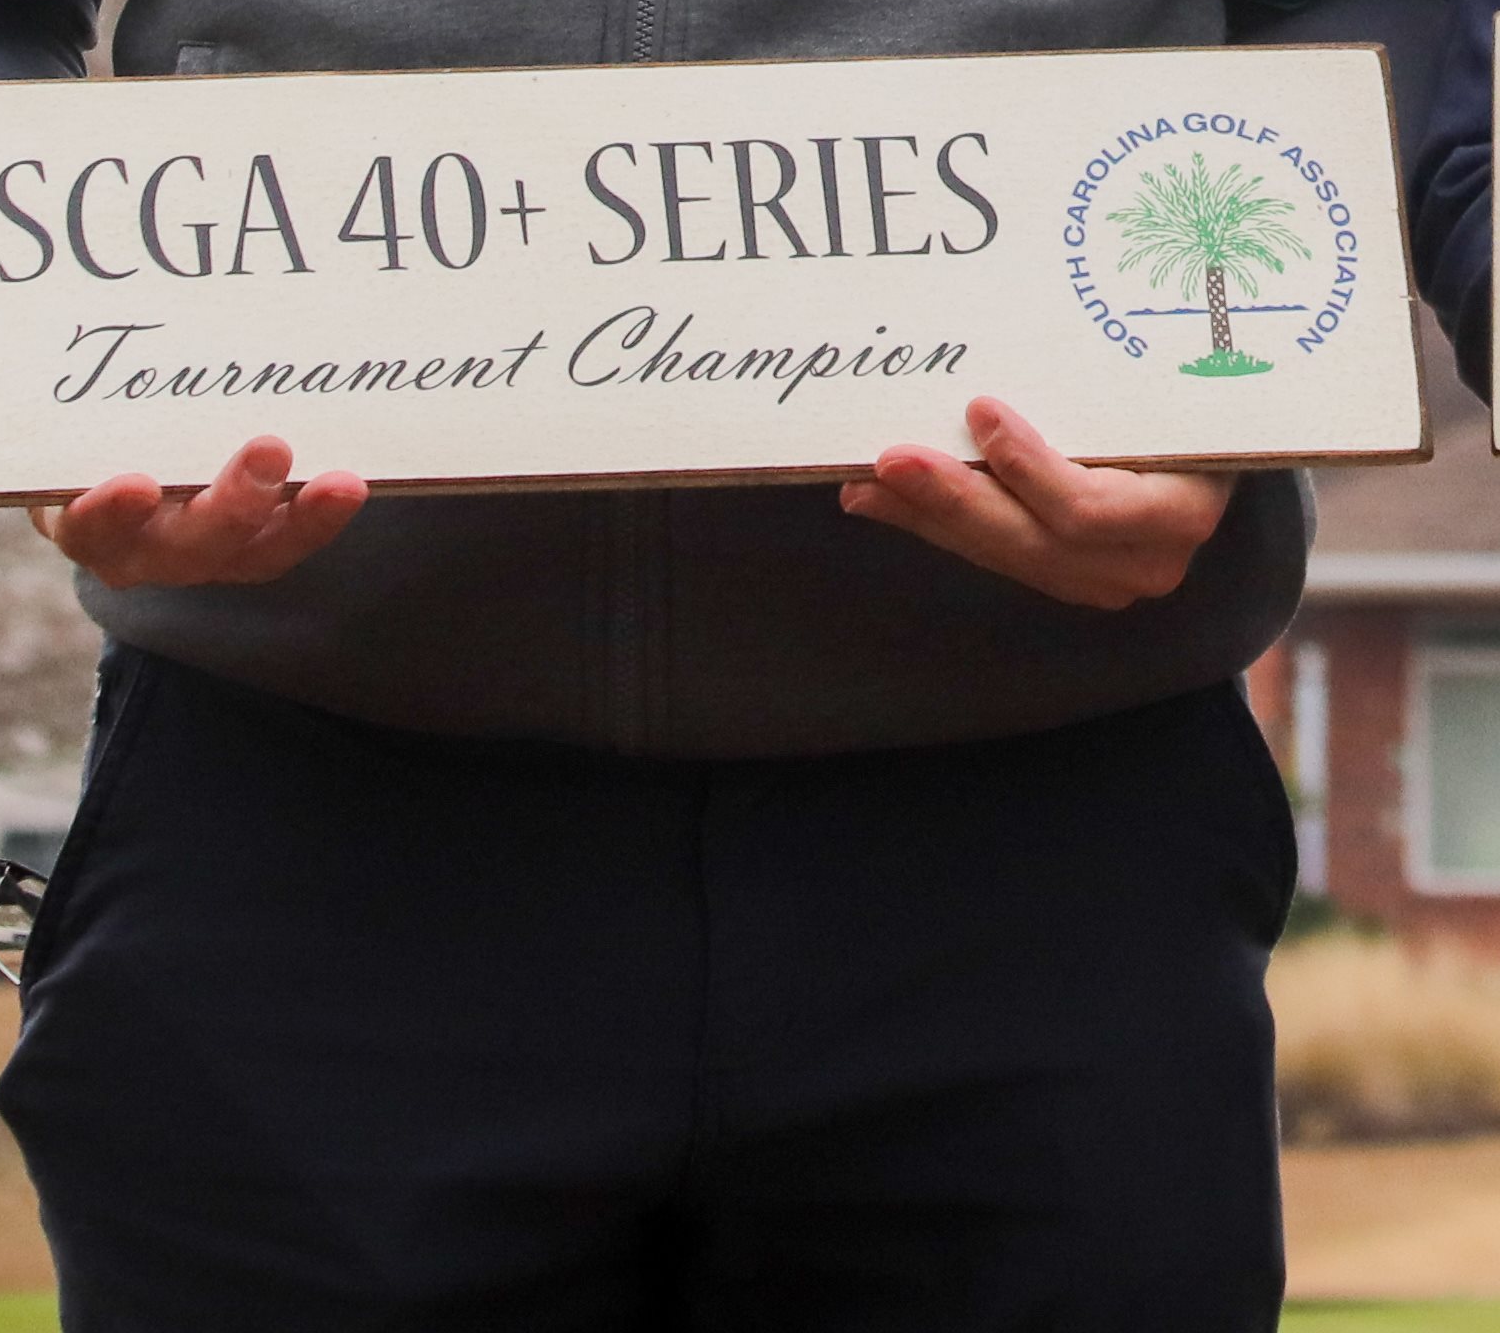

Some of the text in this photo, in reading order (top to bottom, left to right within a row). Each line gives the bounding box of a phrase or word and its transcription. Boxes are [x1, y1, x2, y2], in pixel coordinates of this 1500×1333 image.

[336, 151, 548, 273] 40+
[586, 132, 1000, 266] SERIES
[1063, 112, 1359, 359] SOUTH CAROLINA GOLF ASSOCIATION
[53, 305, 970, 406] Tournament Champion
